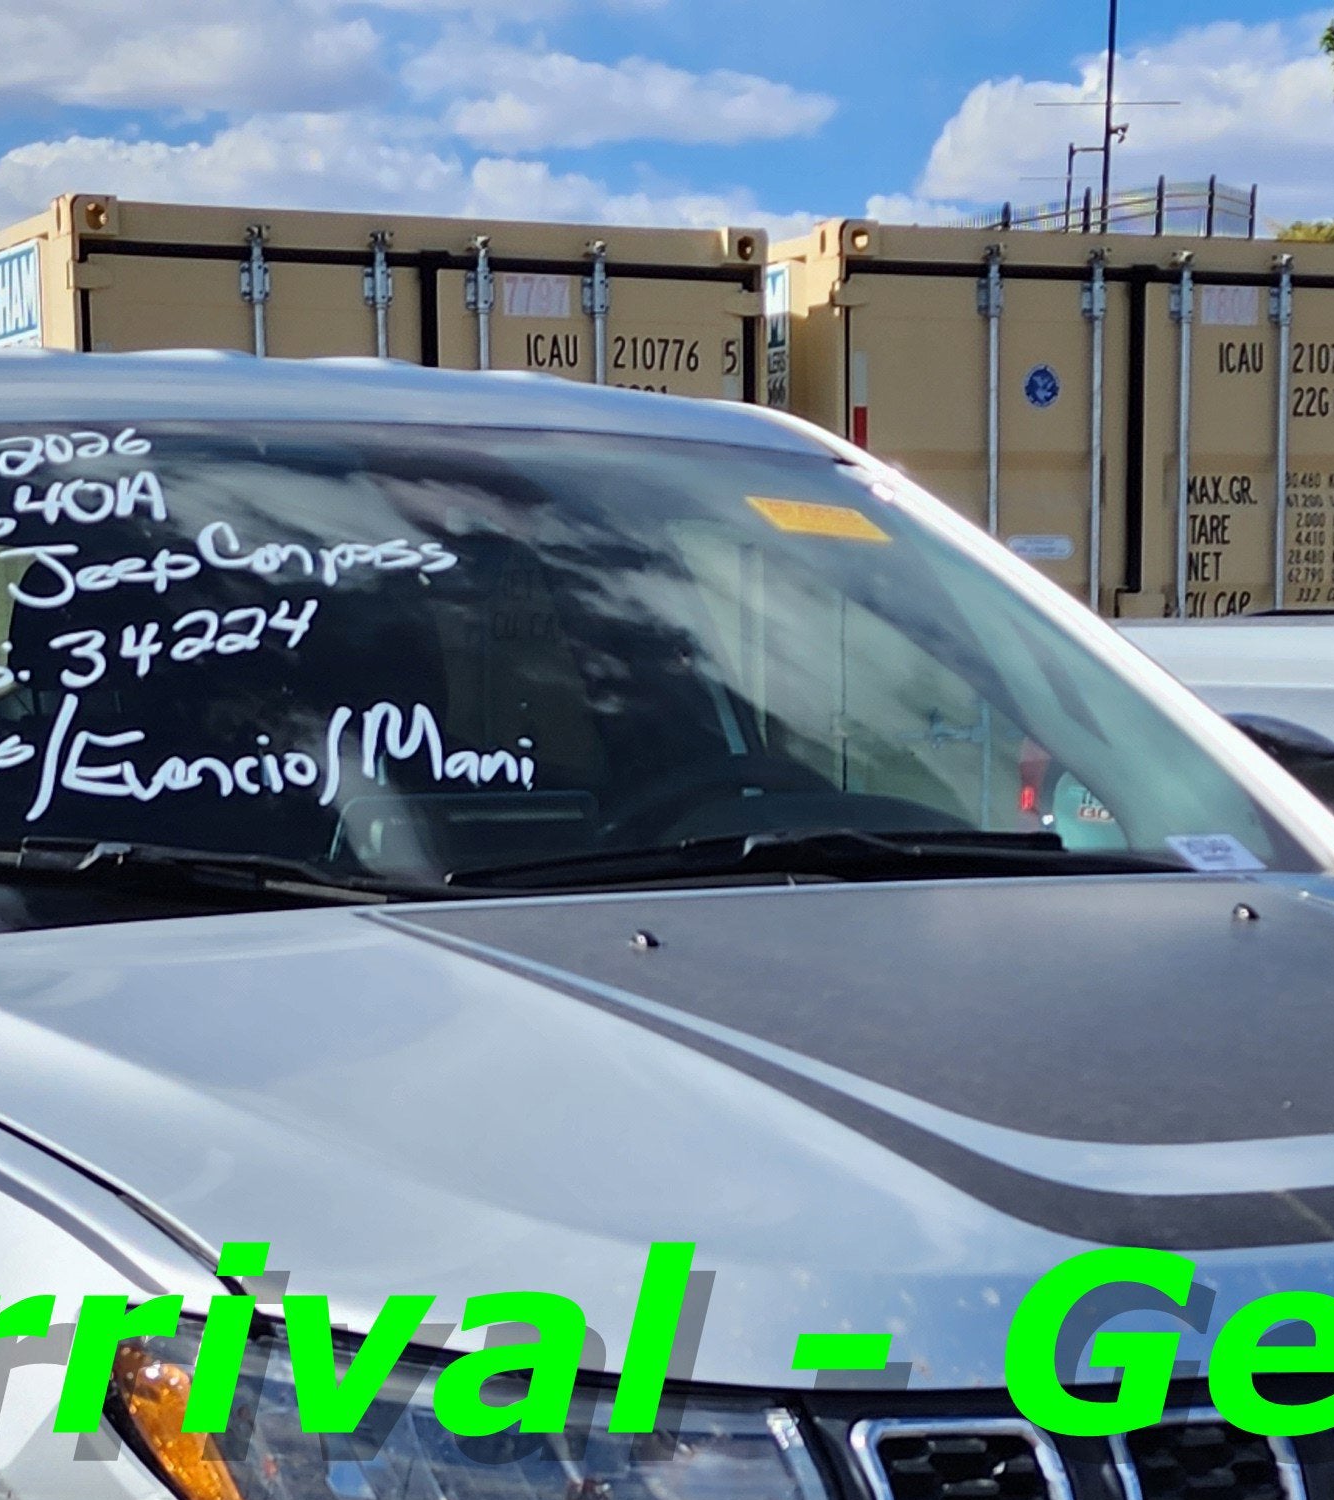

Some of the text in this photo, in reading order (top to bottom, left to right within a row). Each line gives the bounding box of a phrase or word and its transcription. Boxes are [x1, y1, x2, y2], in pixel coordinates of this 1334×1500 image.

[526, 333, 738, 374] ICAU 210776 5
[1219, 341, 1264, 374] ICAU
[1188, 513, 1231, 545] TARE
[1187, 551, 1223, 582] NET
[50, 599, 319, 689] 34224
